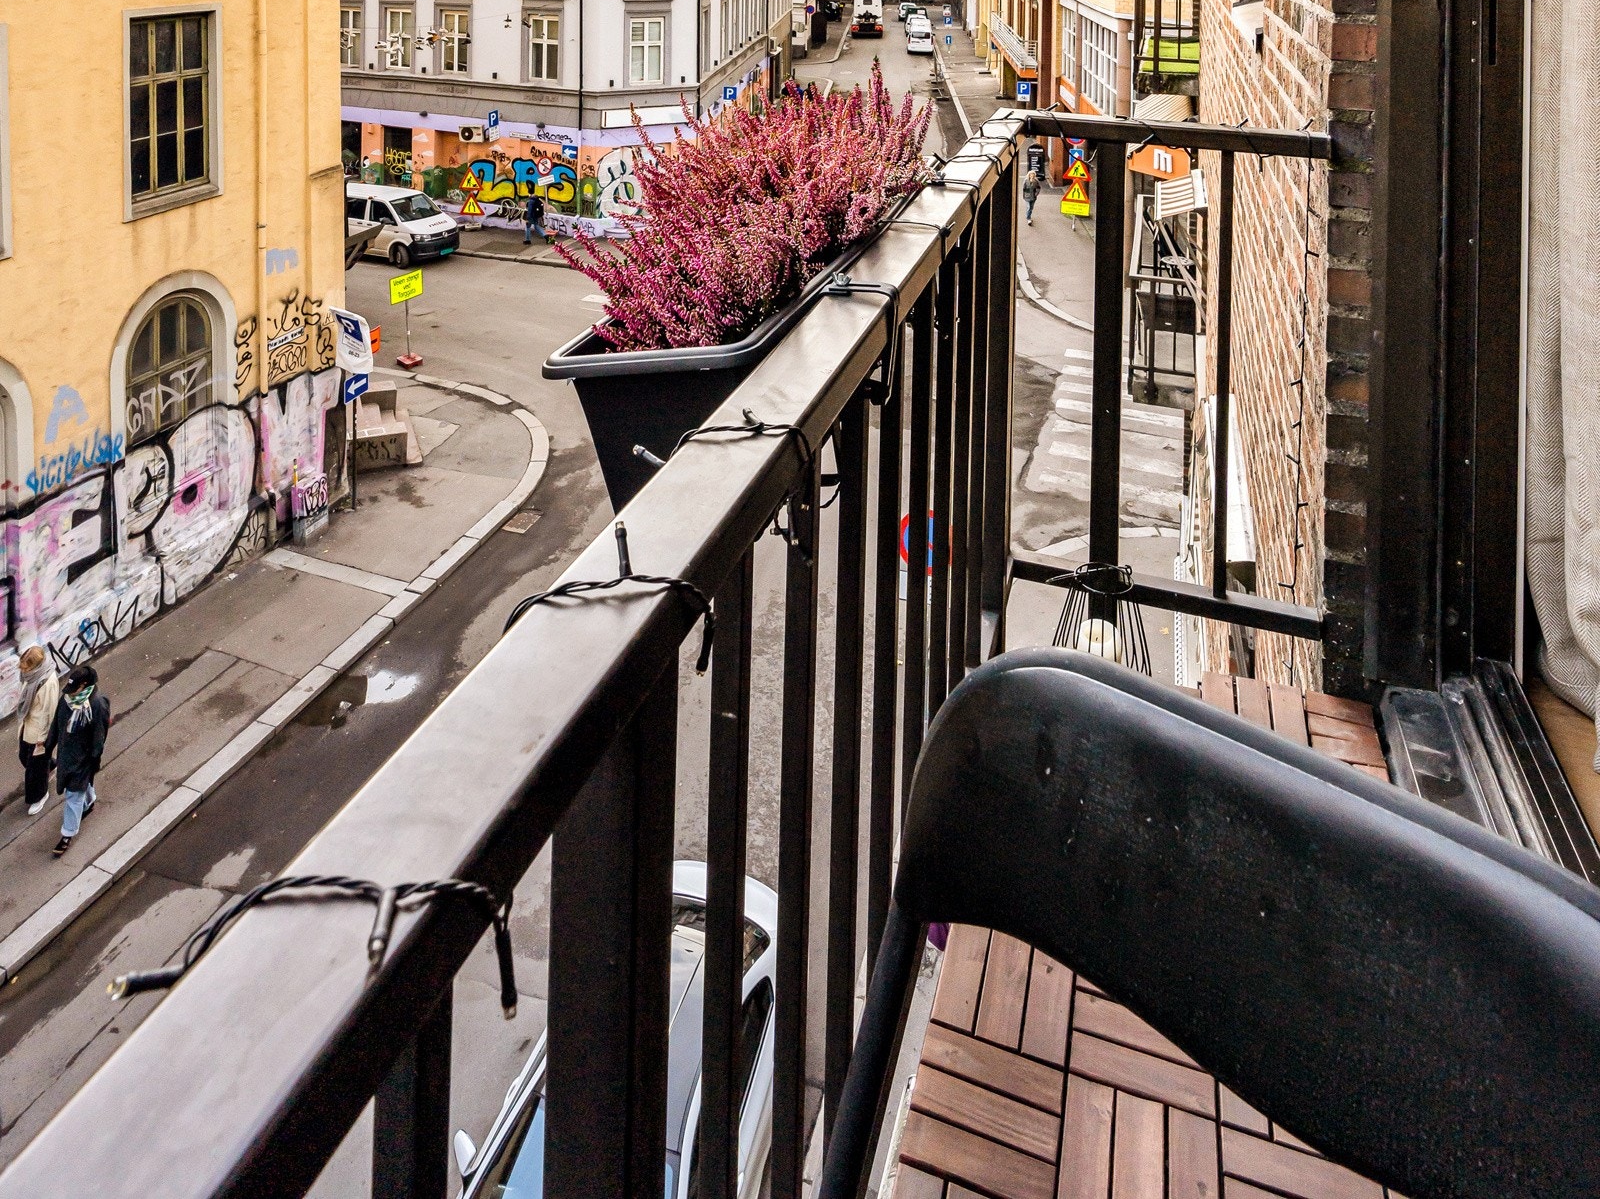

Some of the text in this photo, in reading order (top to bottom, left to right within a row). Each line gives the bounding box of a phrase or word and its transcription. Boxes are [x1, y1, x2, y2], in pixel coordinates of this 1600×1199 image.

[726, 88, 734, 99] P
[1020, 84, 1028, 94] P
[490, 112, 497, 126] P
